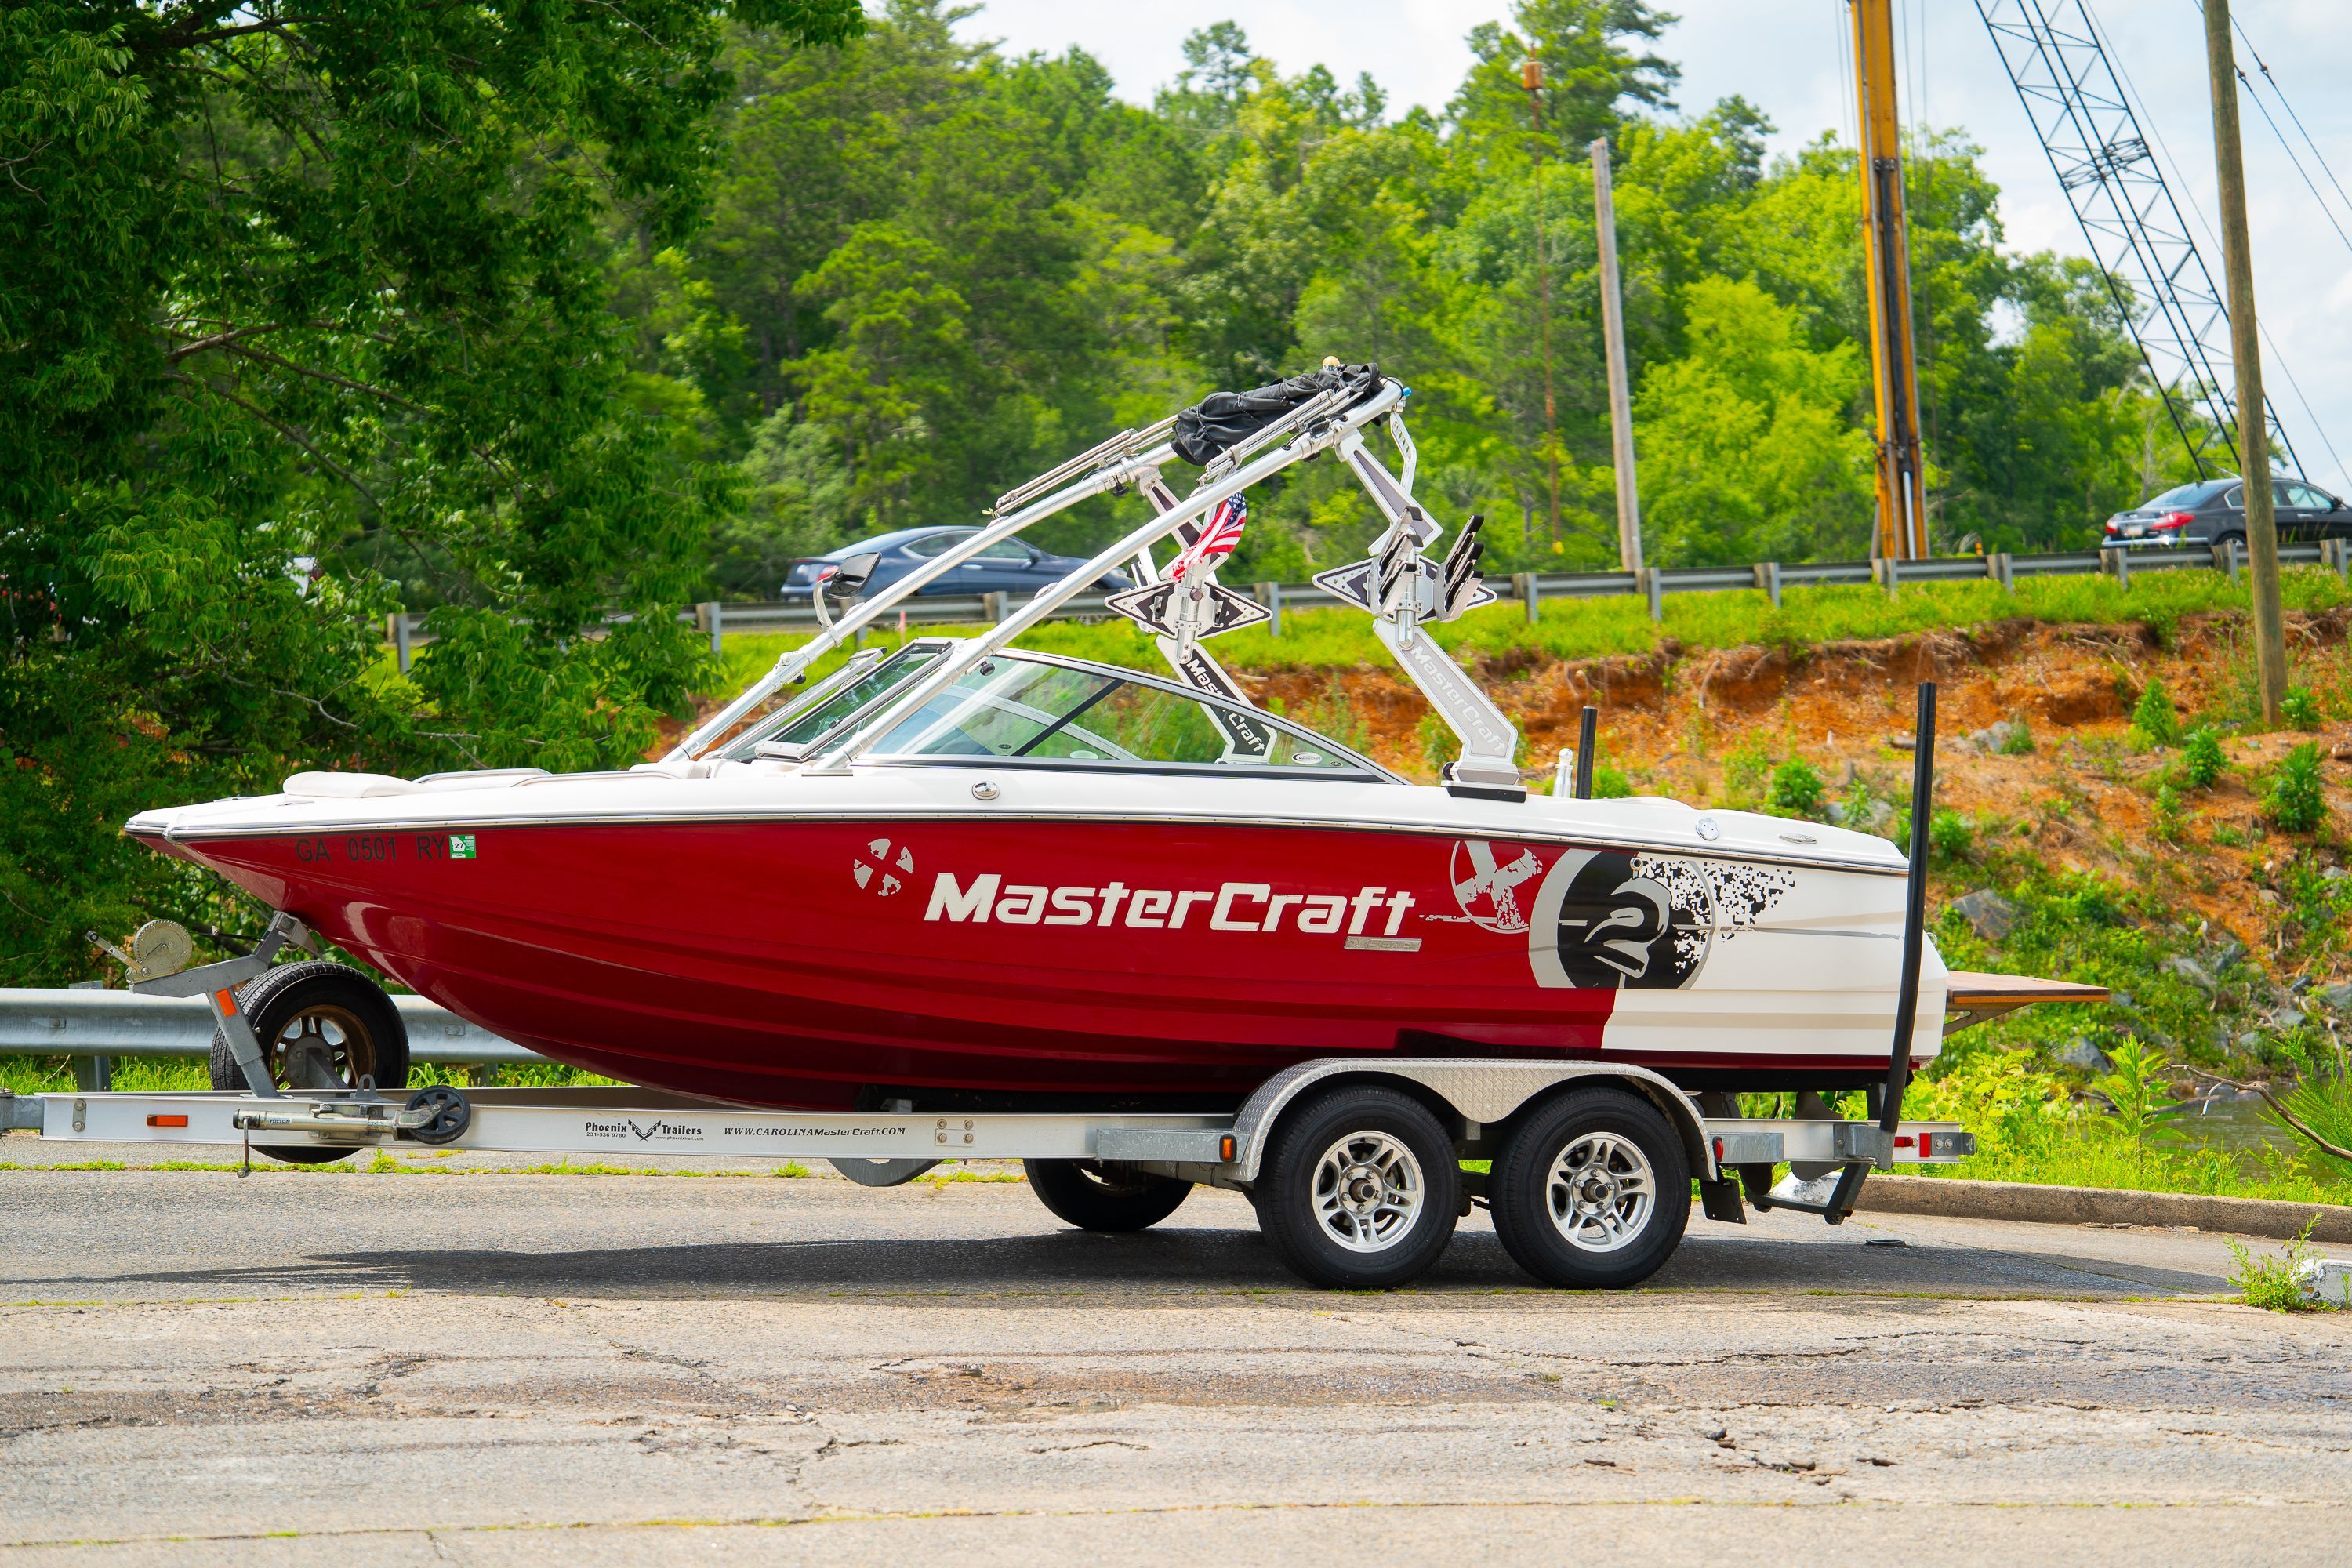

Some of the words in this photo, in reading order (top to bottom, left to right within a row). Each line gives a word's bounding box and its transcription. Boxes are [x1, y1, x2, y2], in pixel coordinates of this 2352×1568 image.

[1410, 645, 1506, 751] MasterCraft
[296, 839, 331, 862] GA
[347, 837, 396, 860] 0501
[417, 835, 446, 858] RY
[924, 873, 1416, 935] MasterCraft
[585, 1122, 627, 1132] Phoenix
[662, 1124, 702, 1135] Trailers
[724, 1127, 906, 1137] WWW.CAROLINAMasterCraft.COM
